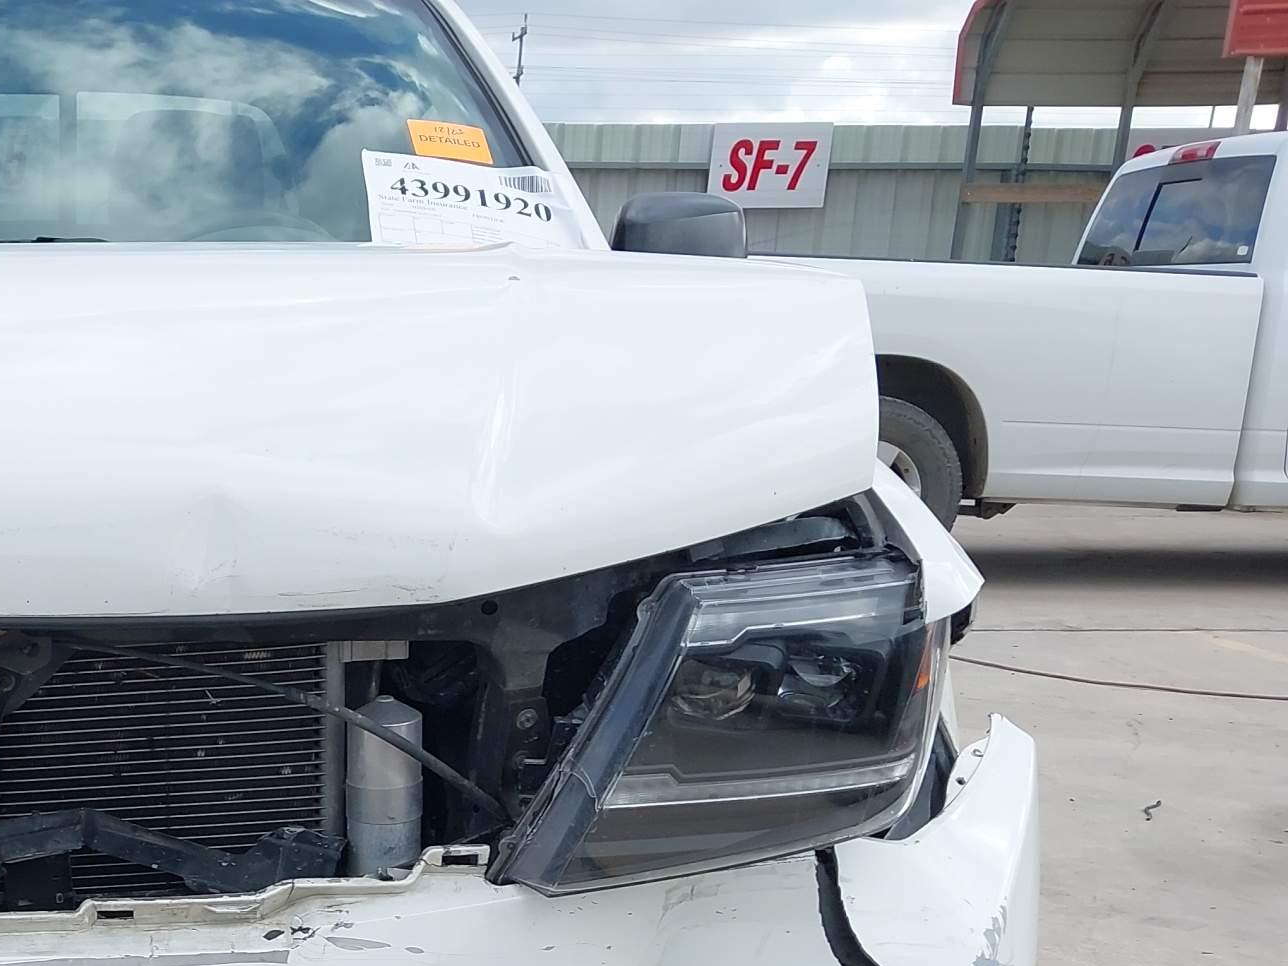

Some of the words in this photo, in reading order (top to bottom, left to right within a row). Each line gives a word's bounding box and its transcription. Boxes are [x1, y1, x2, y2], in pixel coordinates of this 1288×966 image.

[418, 134, 481, 149] DETAILED
[721, 138, 818, 192] SF-7
[390, 177, 552, 222] 43991920
